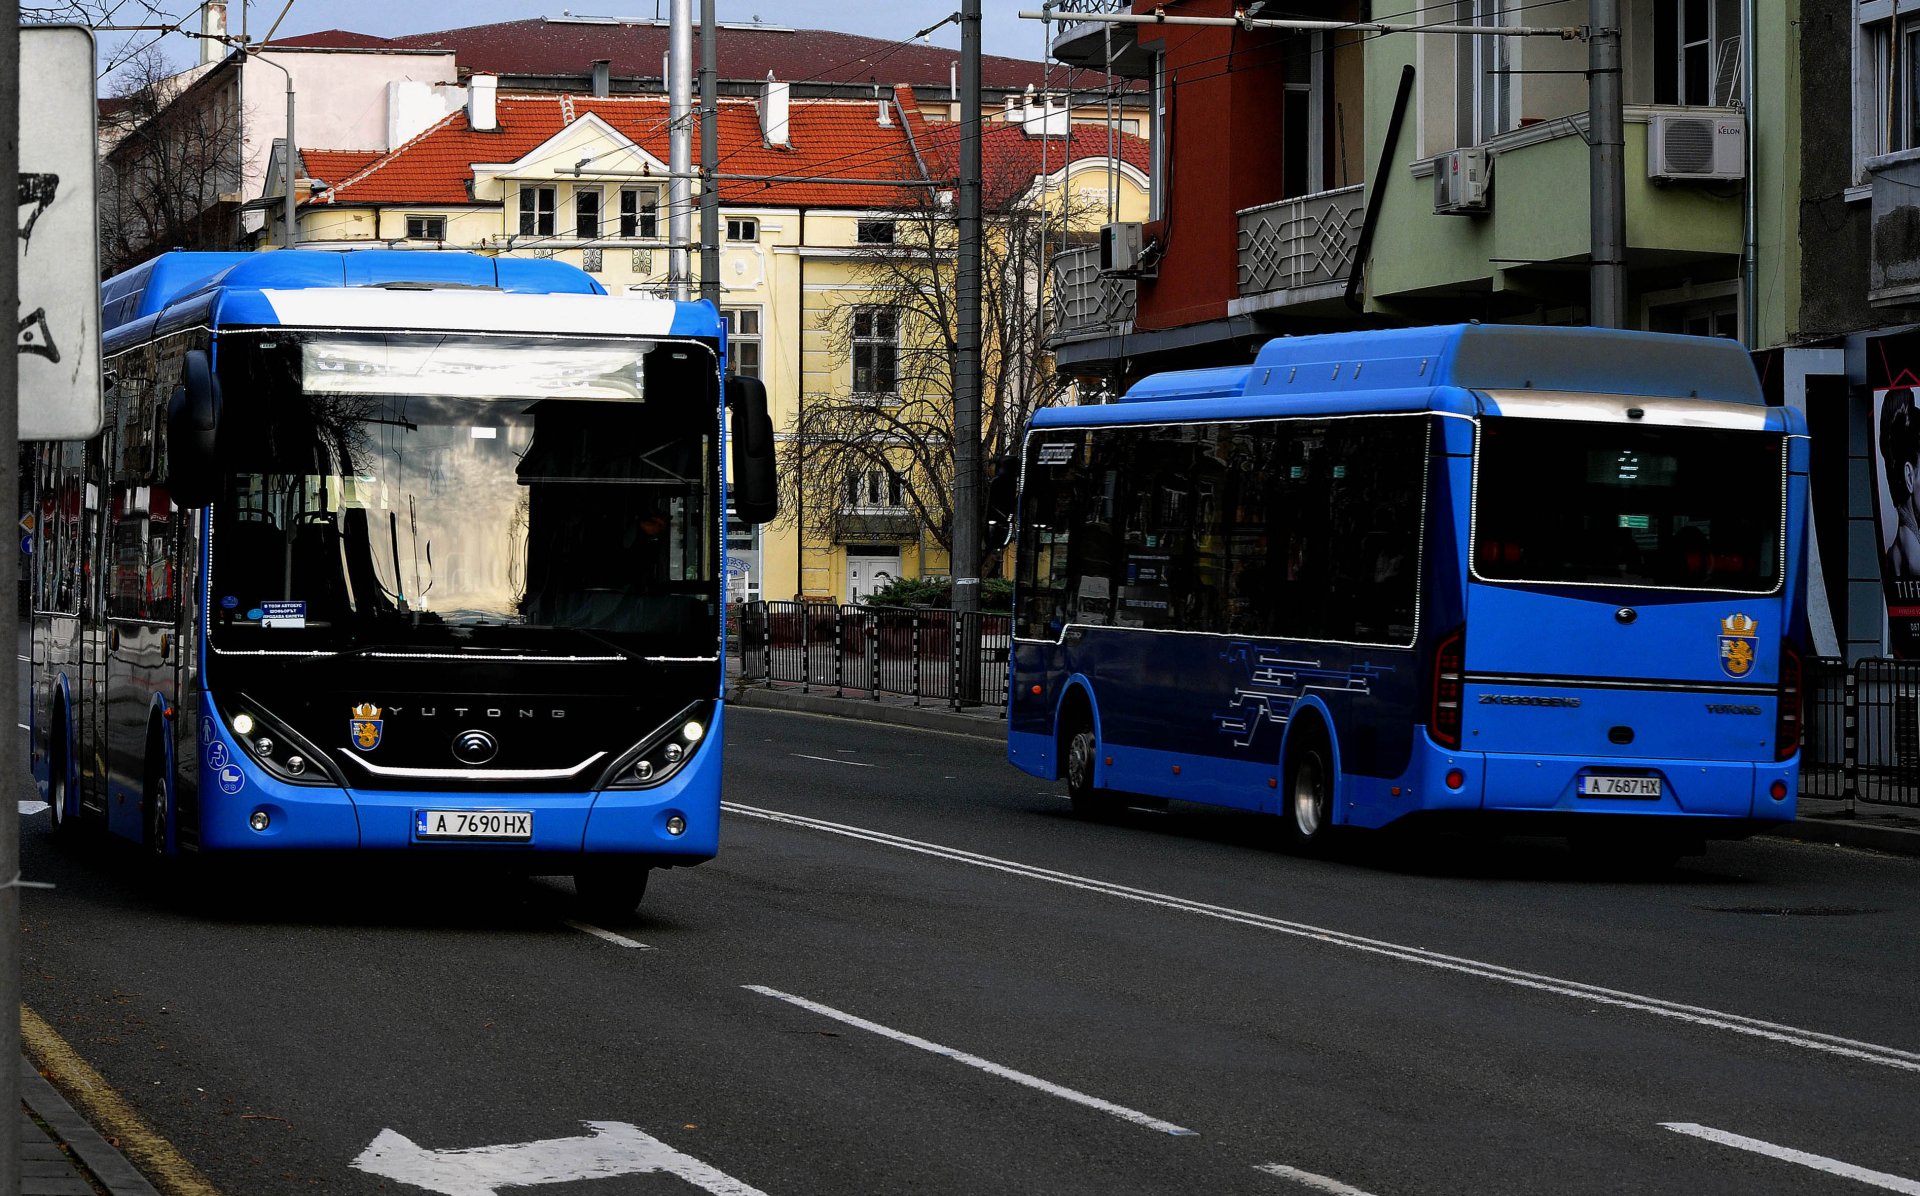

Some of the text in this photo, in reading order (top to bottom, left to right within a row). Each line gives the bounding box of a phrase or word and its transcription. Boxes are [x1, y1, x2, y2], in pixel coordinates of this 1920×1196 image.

[1718, 126, 1740, 135] KELON
[727, 557, 751, 572] ESS
[389, 706, 565, 718] YUTONG
